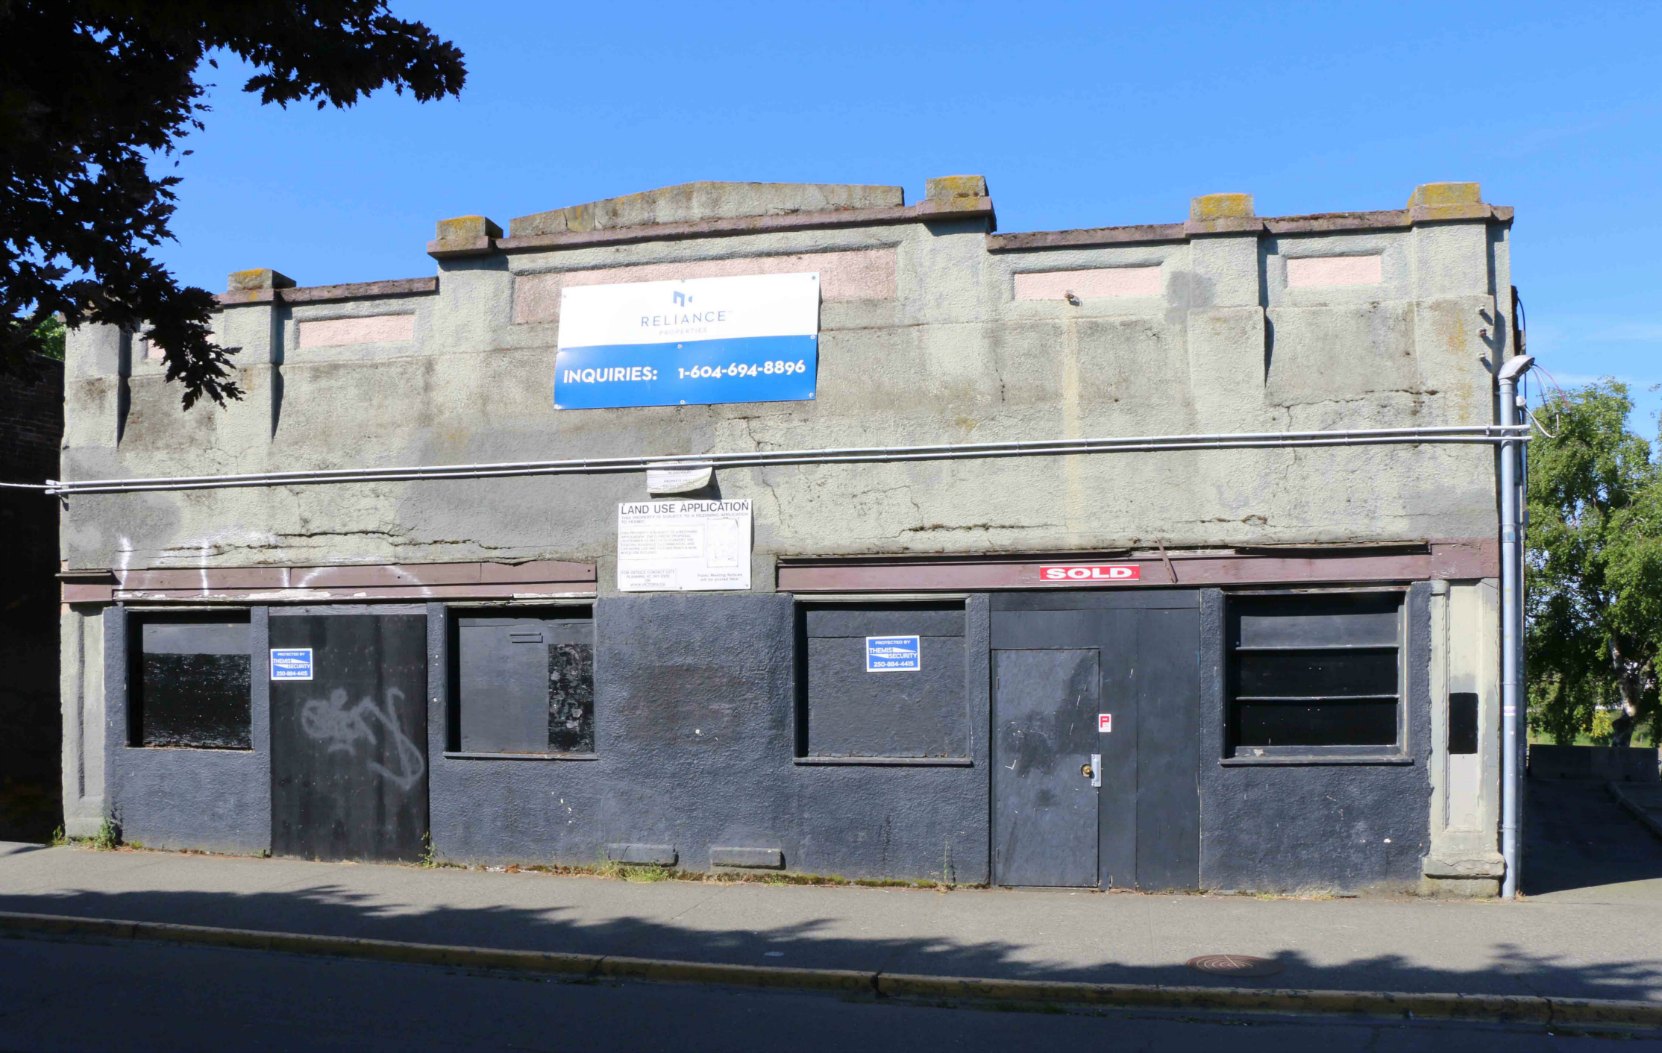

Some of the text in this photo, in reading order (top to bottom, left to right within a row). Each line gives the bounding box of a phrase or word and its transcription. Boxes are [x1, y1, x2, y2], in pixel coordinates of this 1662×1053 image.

[641, 311, 727, 327] RELIANCE
[563, 359, 806, 384] INQUIRIES: 1-604-694-8896
[621, 501, 749, 515] LAND USE APPLICATION
[1046, 567, 1132, 579] SOLD
